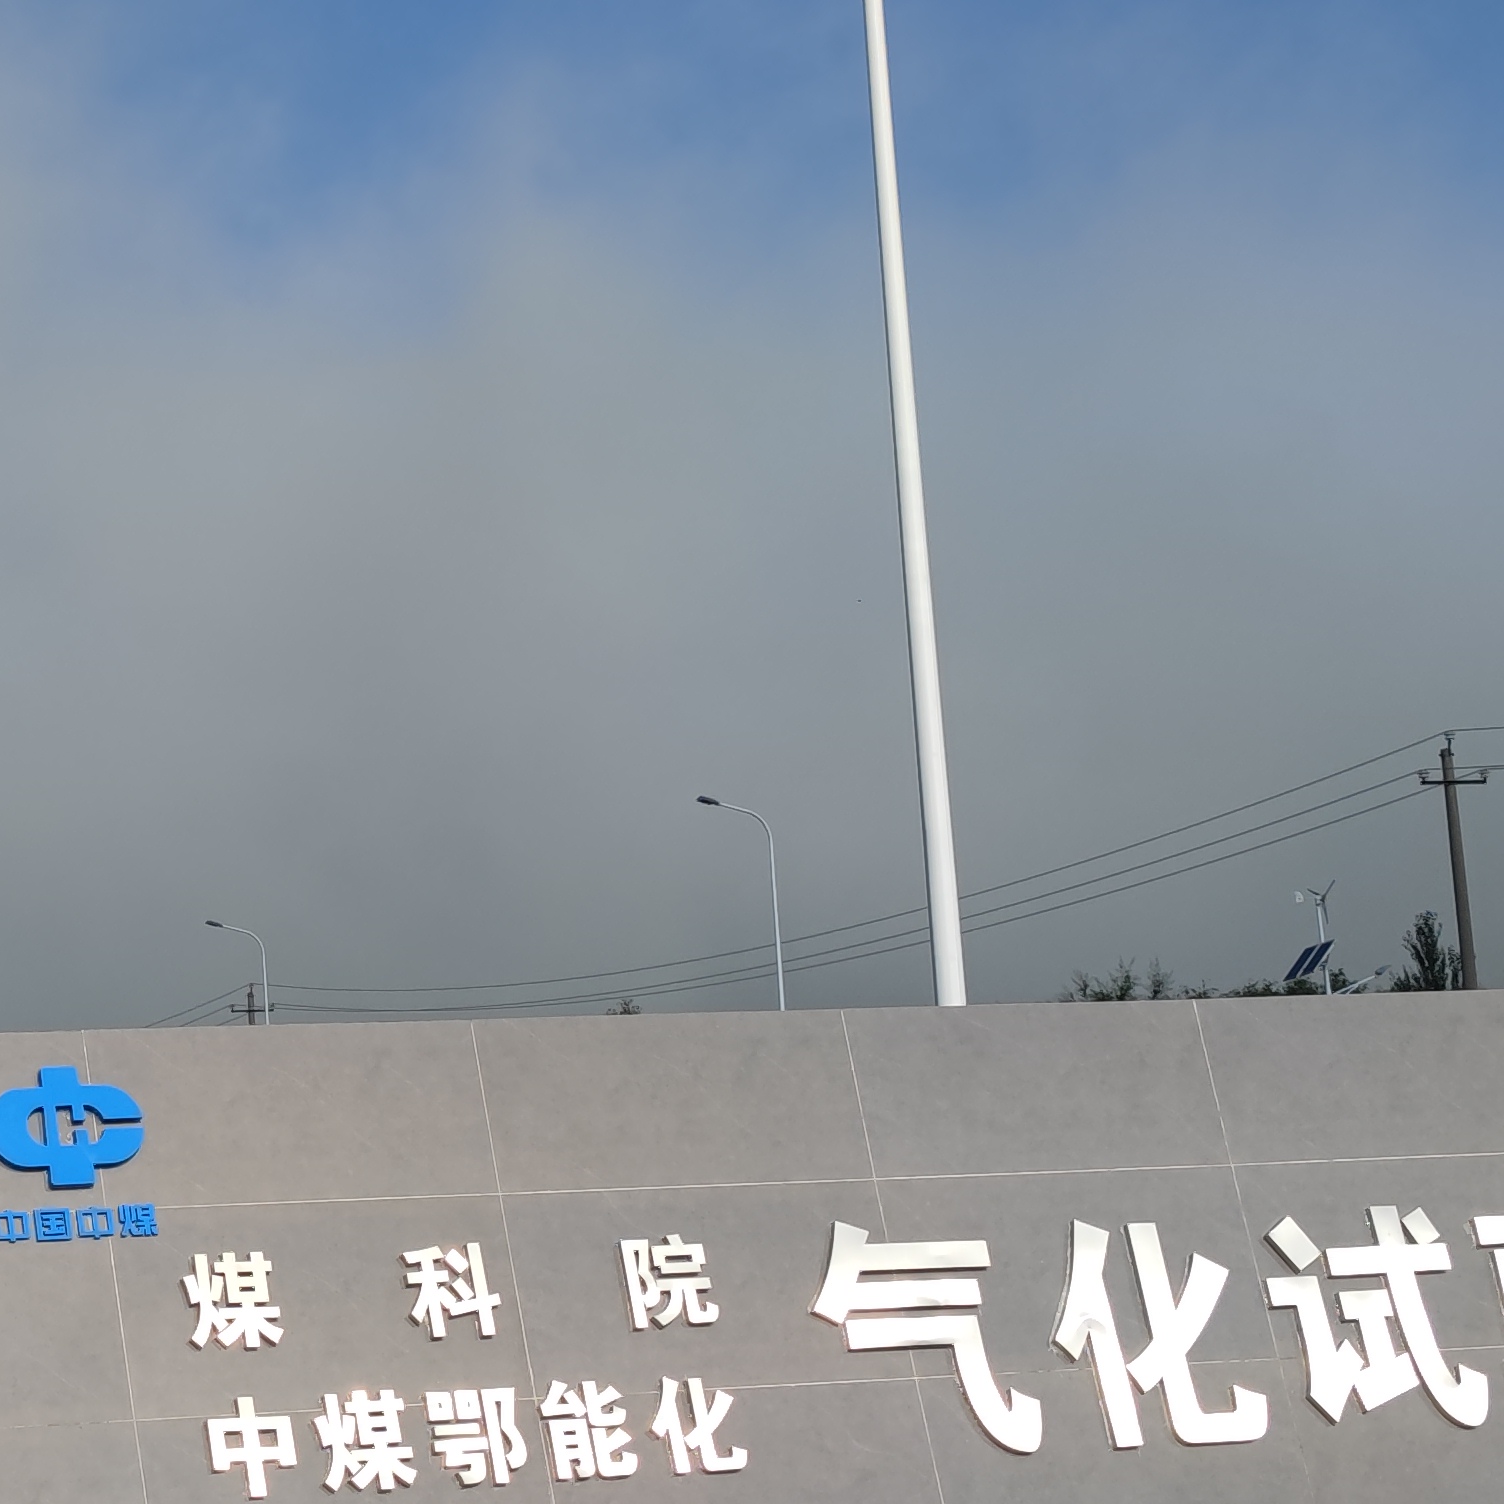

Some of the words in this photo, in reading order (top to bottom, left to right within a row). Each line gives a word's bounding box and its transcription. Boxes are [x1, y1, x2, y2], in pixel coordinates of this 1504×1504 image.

[207, 1376, 749, 1499] 中煤鄂能化
